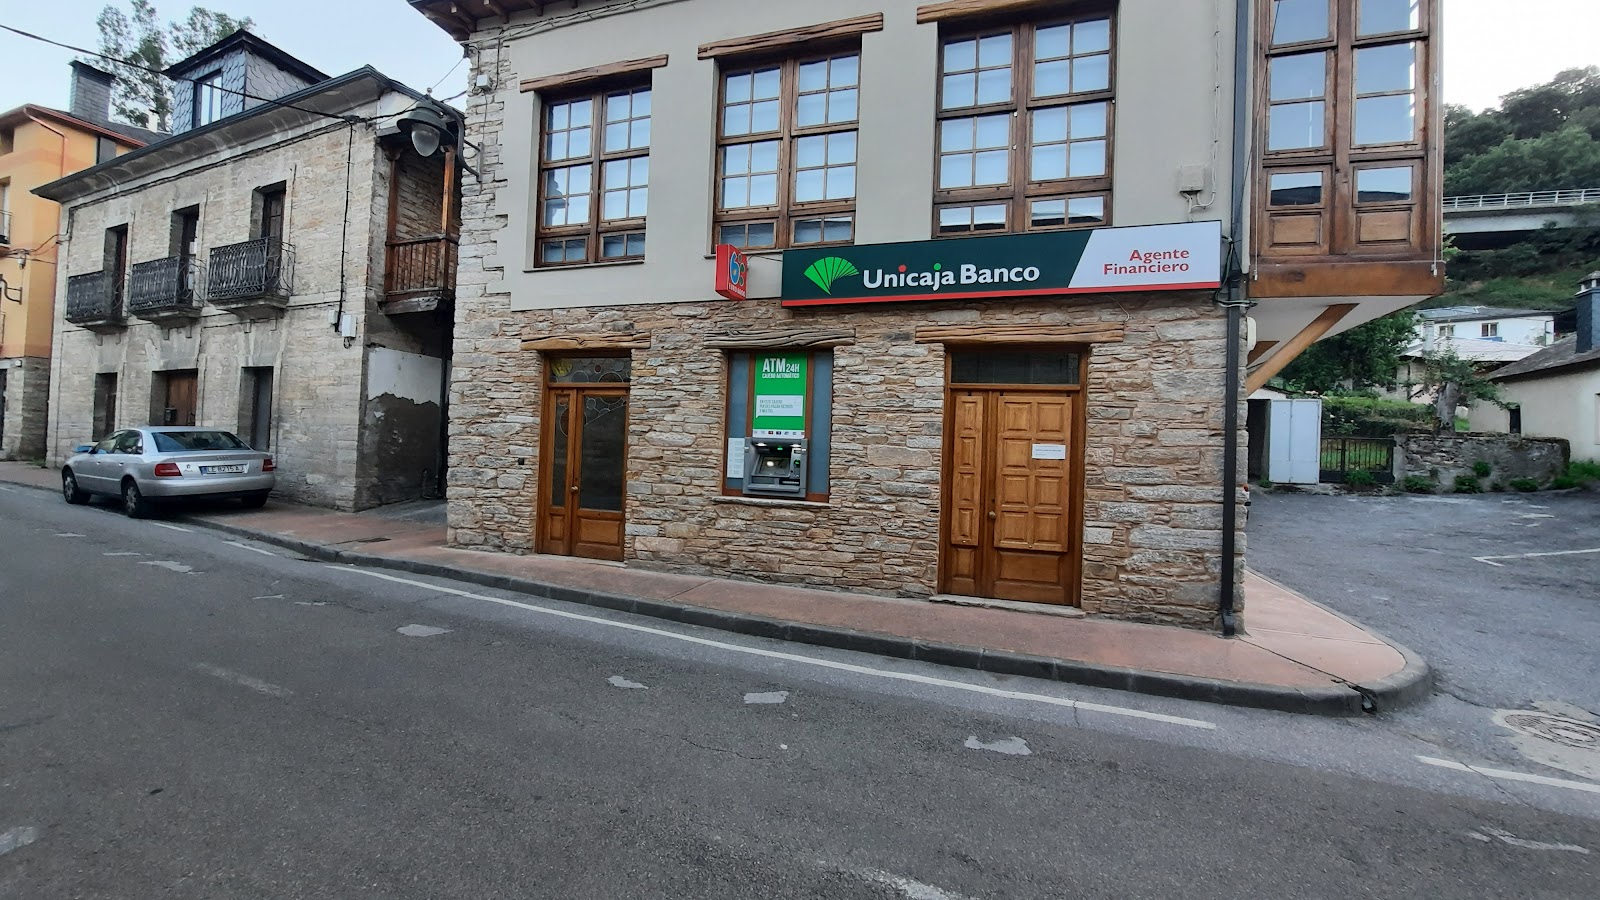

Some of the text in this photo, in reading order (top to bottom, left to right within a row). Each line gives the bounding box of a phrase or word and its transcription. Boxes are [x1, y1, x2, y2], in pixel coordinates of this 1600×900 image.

[1129, 249, 1190, 264] Agente
[1103, 261, 1189, 275] Financiero
[863, 263, 1040, 291] Unicaja Banco
[762, 358, 800, 372] ATM 24H
